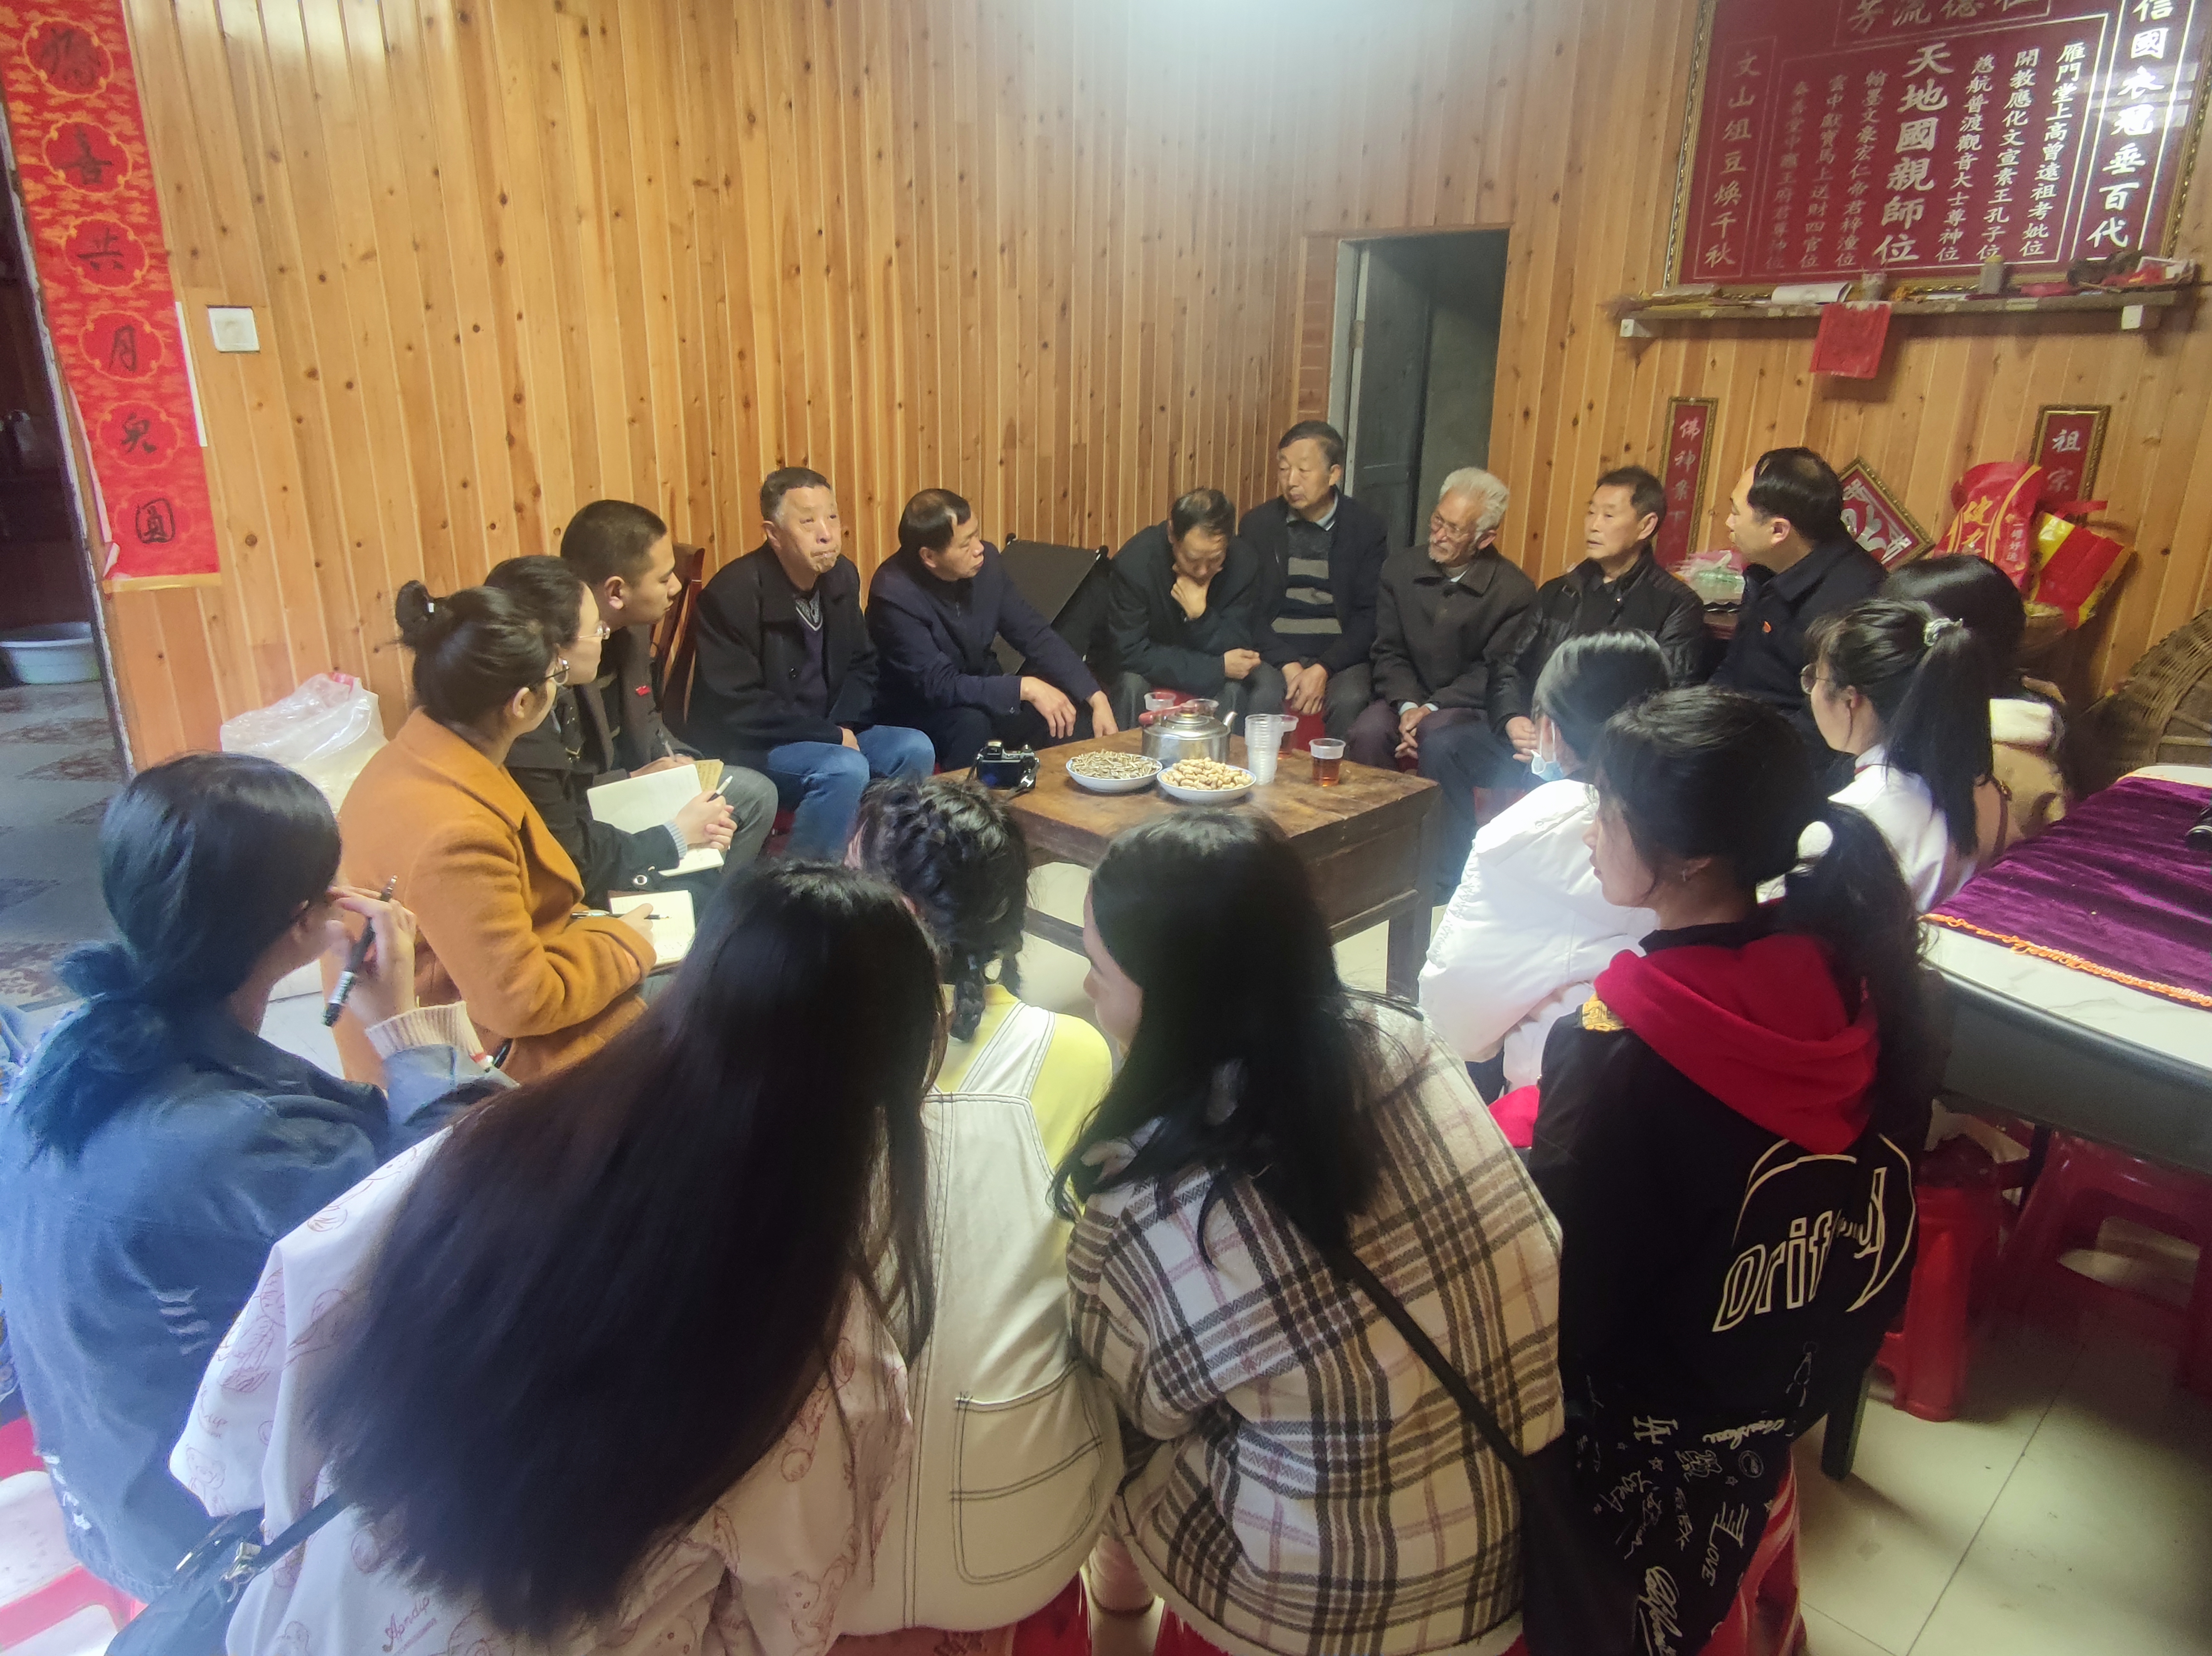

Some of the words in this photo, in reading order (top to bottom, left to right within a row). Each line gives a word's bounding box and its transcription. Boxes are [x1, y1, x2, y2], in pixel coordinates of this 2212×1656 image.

[1872, 42, 1954, 265] 天地國親師位
[1976, 48, 2039, 260] 開教應化文宣素王孔子位
[2019, 42, 2086, 257] 雁門堂上高曾遠祖考妣位
[2086, 0, 2174, 248] 信國衣冠垂百代
